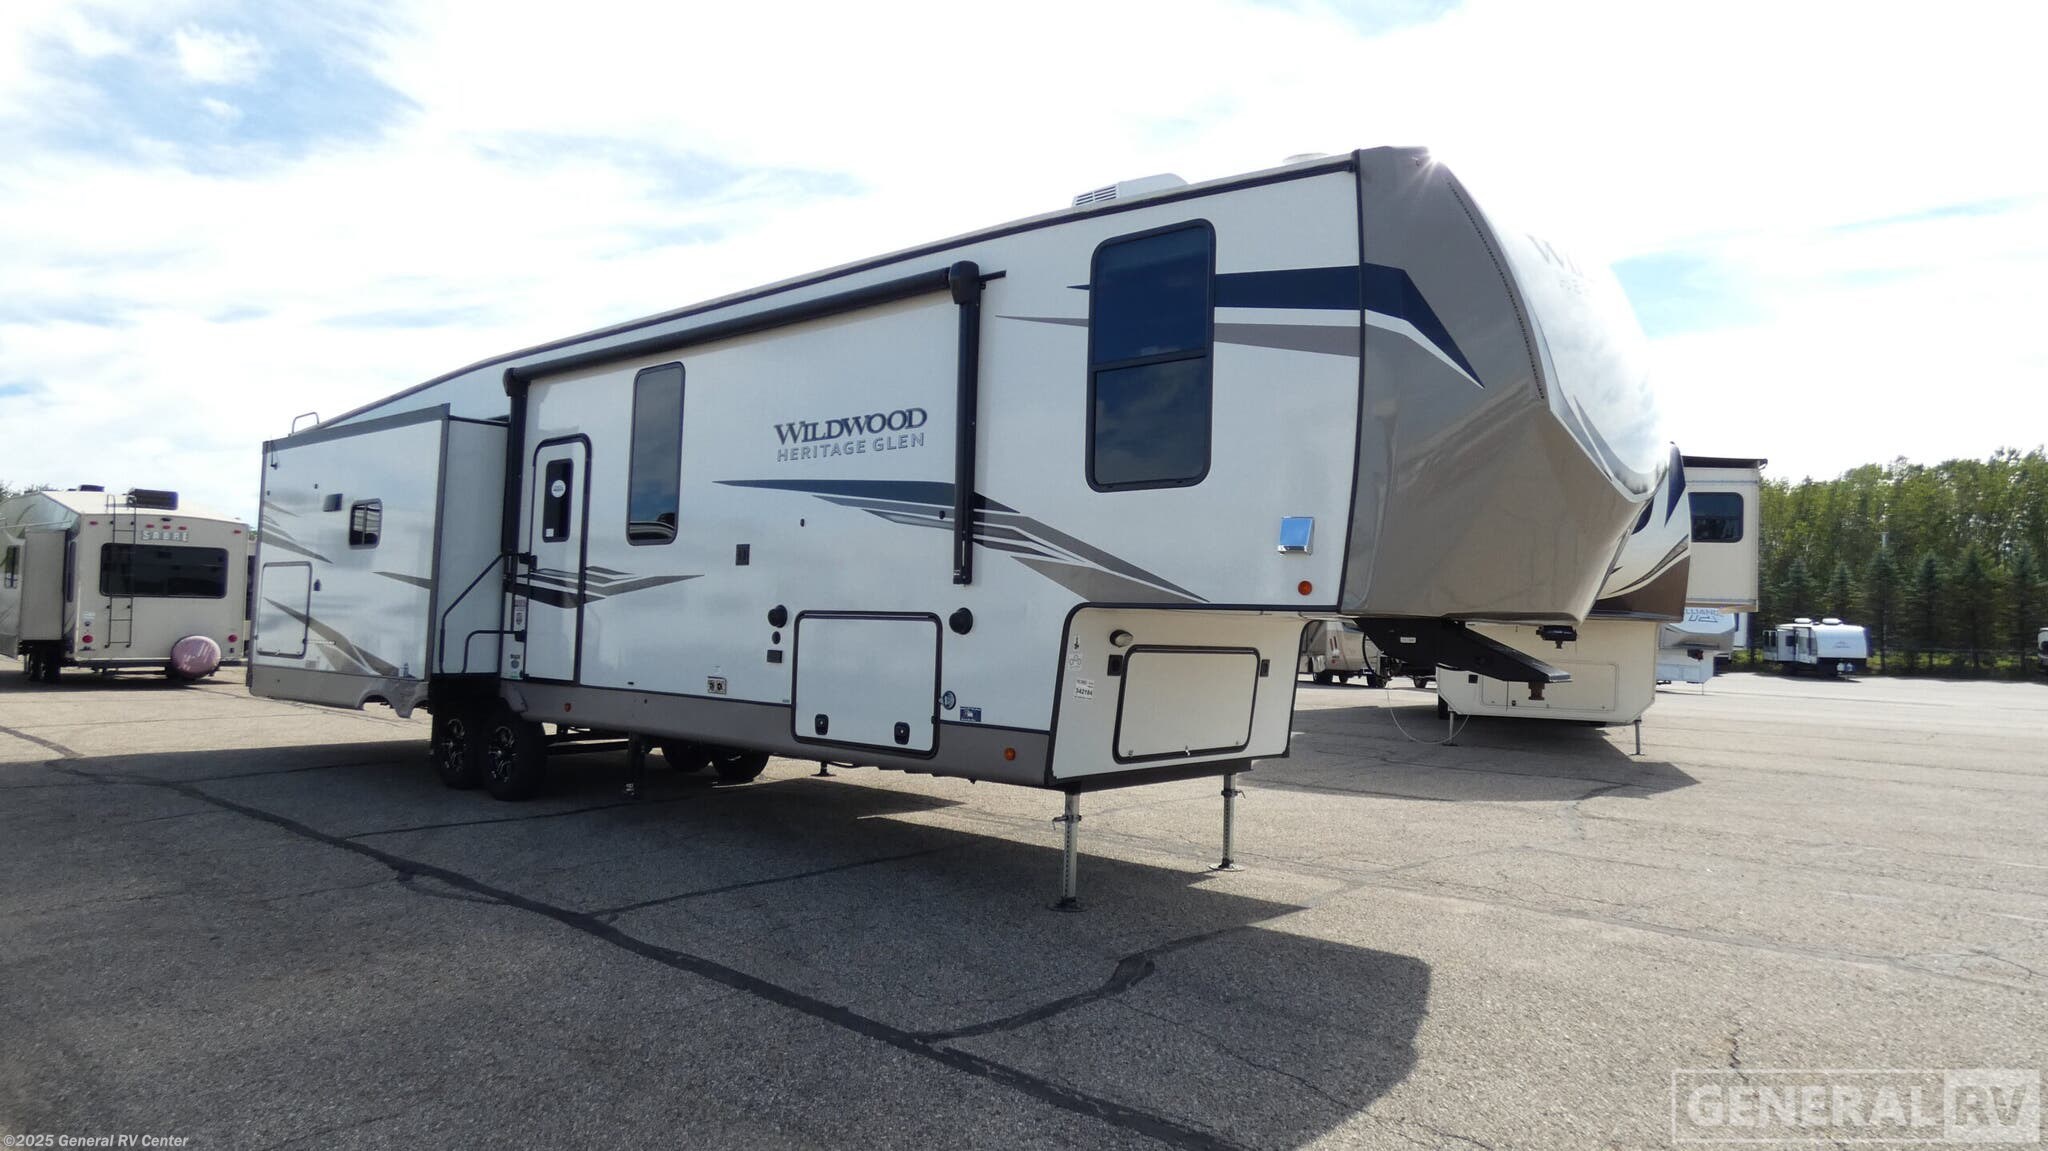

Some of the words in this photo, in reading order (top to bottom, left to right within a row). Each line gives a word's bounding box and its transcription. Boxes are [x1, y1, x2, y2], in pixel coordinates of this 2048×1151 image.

[774, 407, 928, 445] WILDWOOD
[776, 440, 867, 462] HERITAGE
[872, 432, 925, 452] GLEN
[142, 530, 188, 542] SABRE
